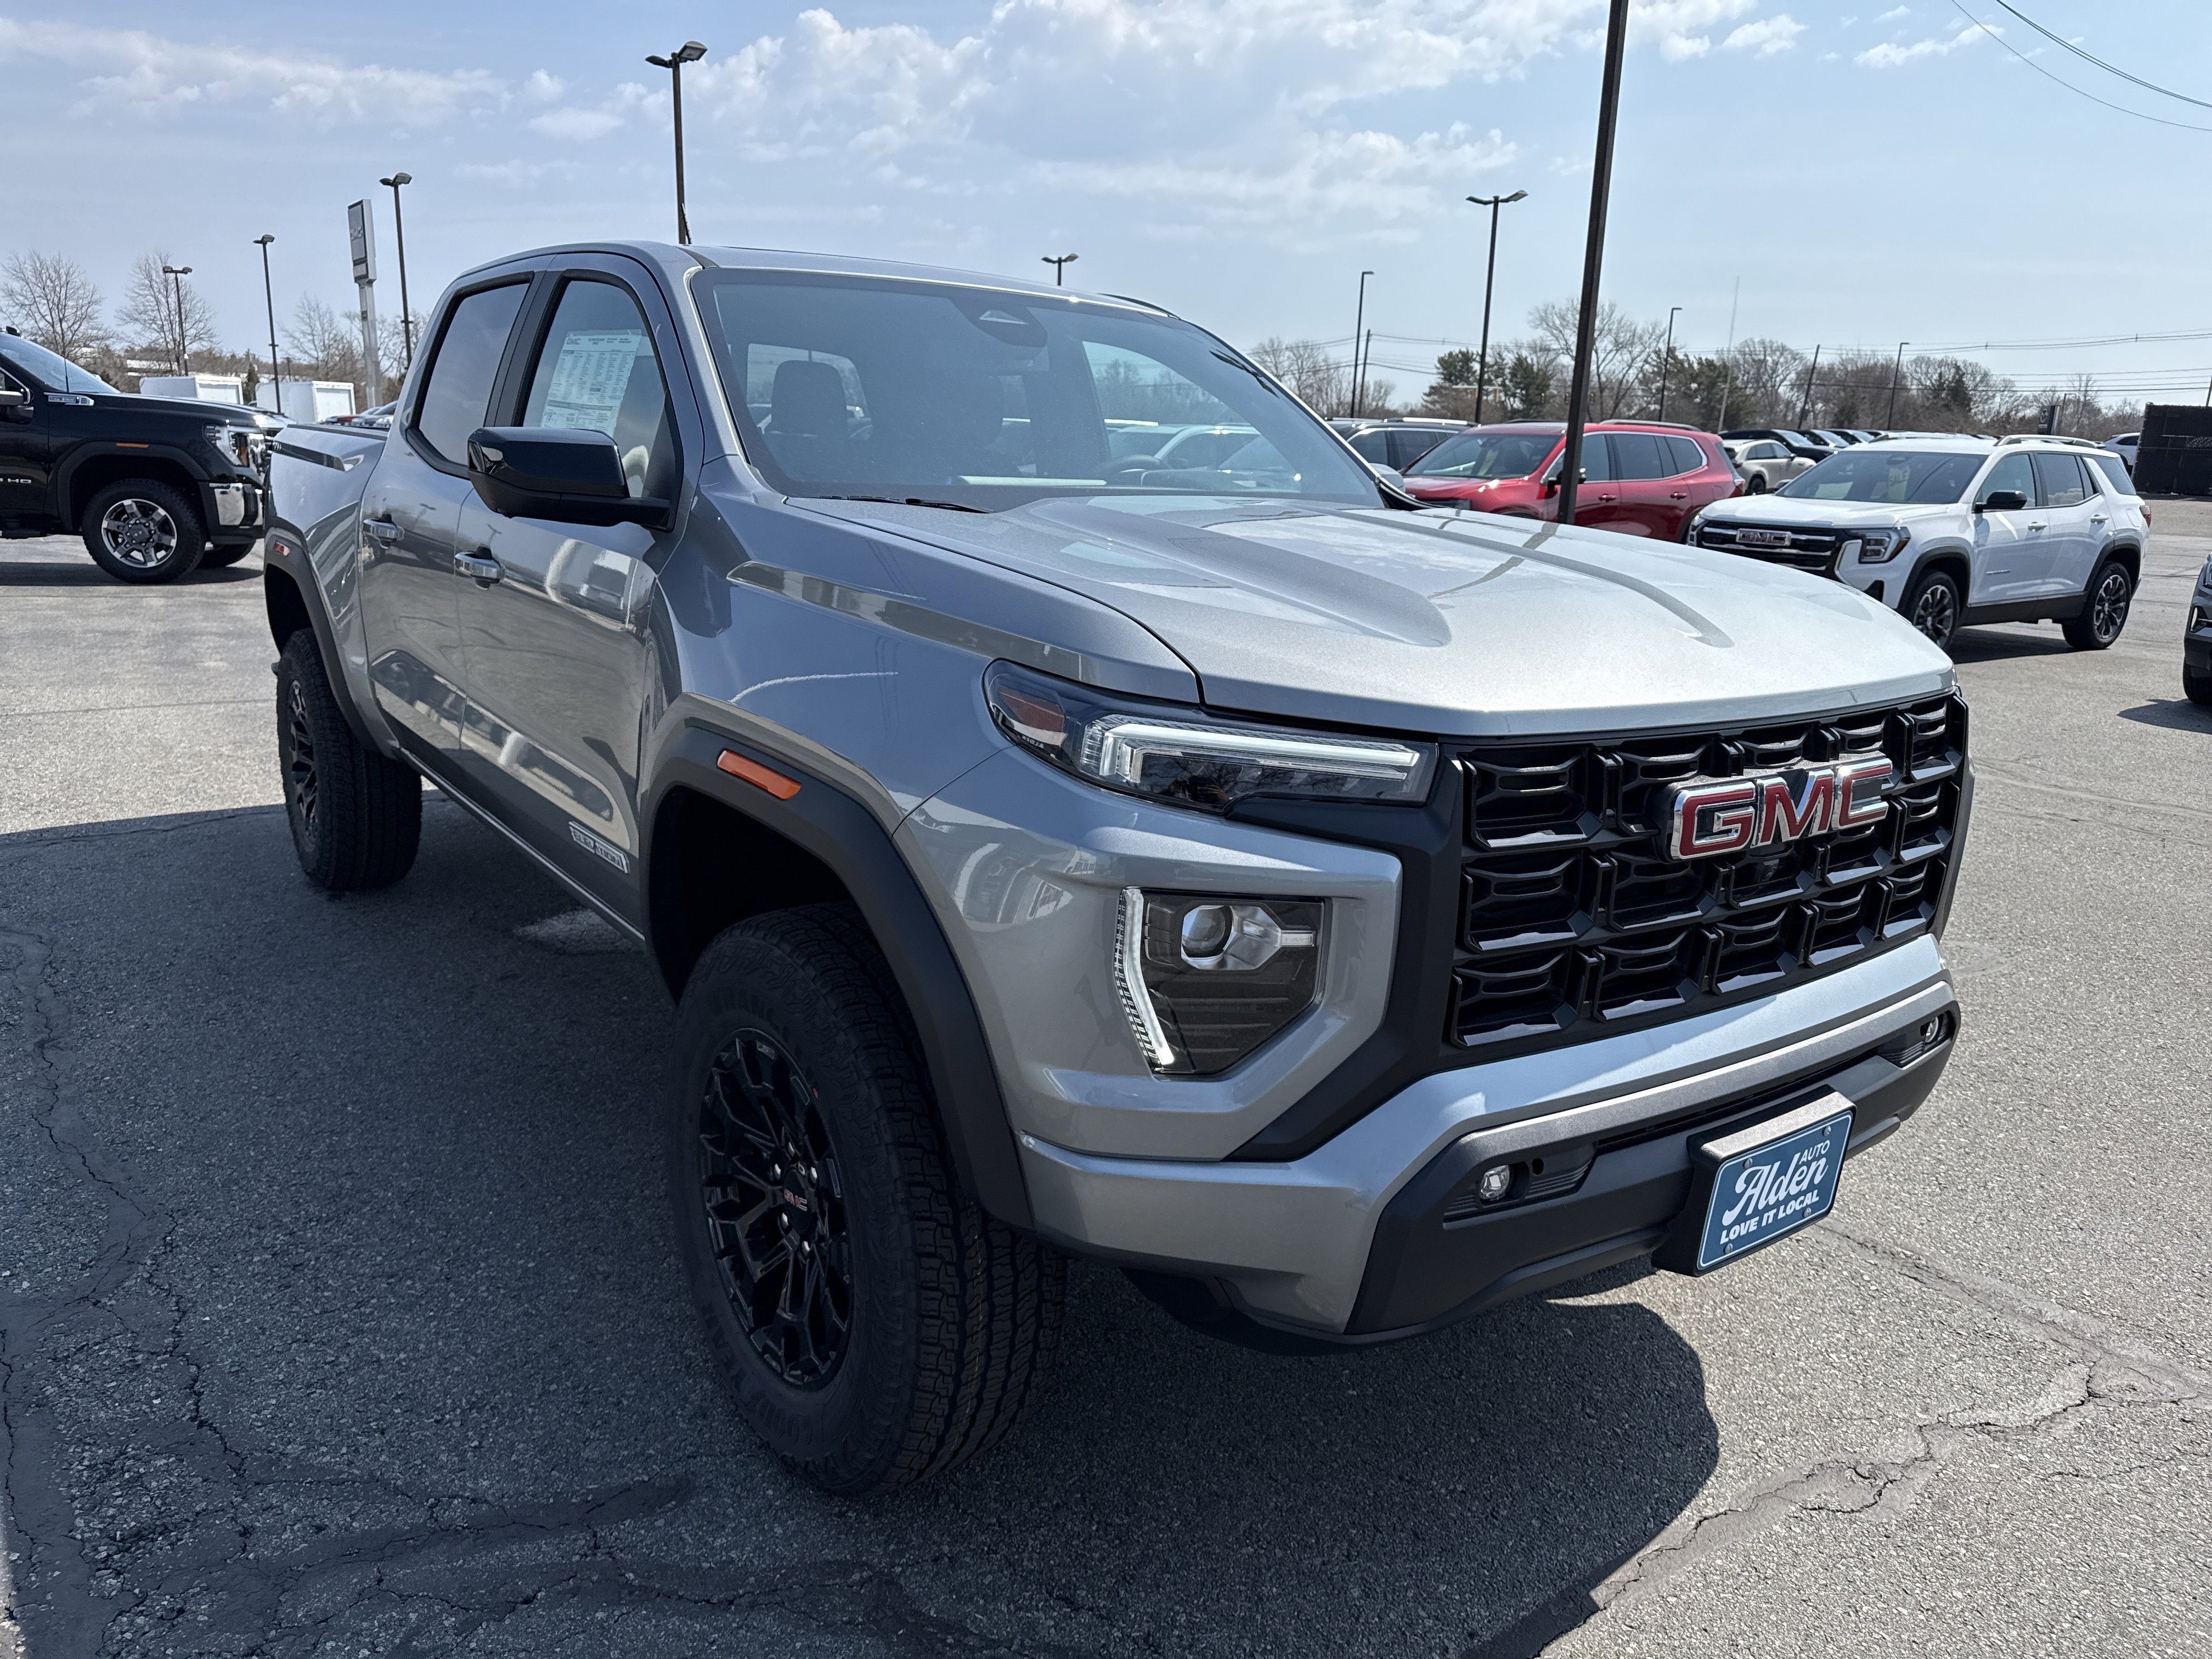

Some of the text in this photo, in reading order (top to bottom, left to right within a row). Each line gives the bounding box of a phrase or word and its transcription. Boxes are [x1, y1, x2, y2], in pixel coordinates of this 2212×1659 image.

[1739, 529, 1786, 545] GMC
[1671, 758, 1893, 860] GMC
[1799, 1139, 1830, 1165] AUTO
[784, 1188, 808, 1211] GMC
[1722, 1153, 1829, 1226] Alden
[1719, 1189, 1820, 1244] LOVE IT LOCAL
